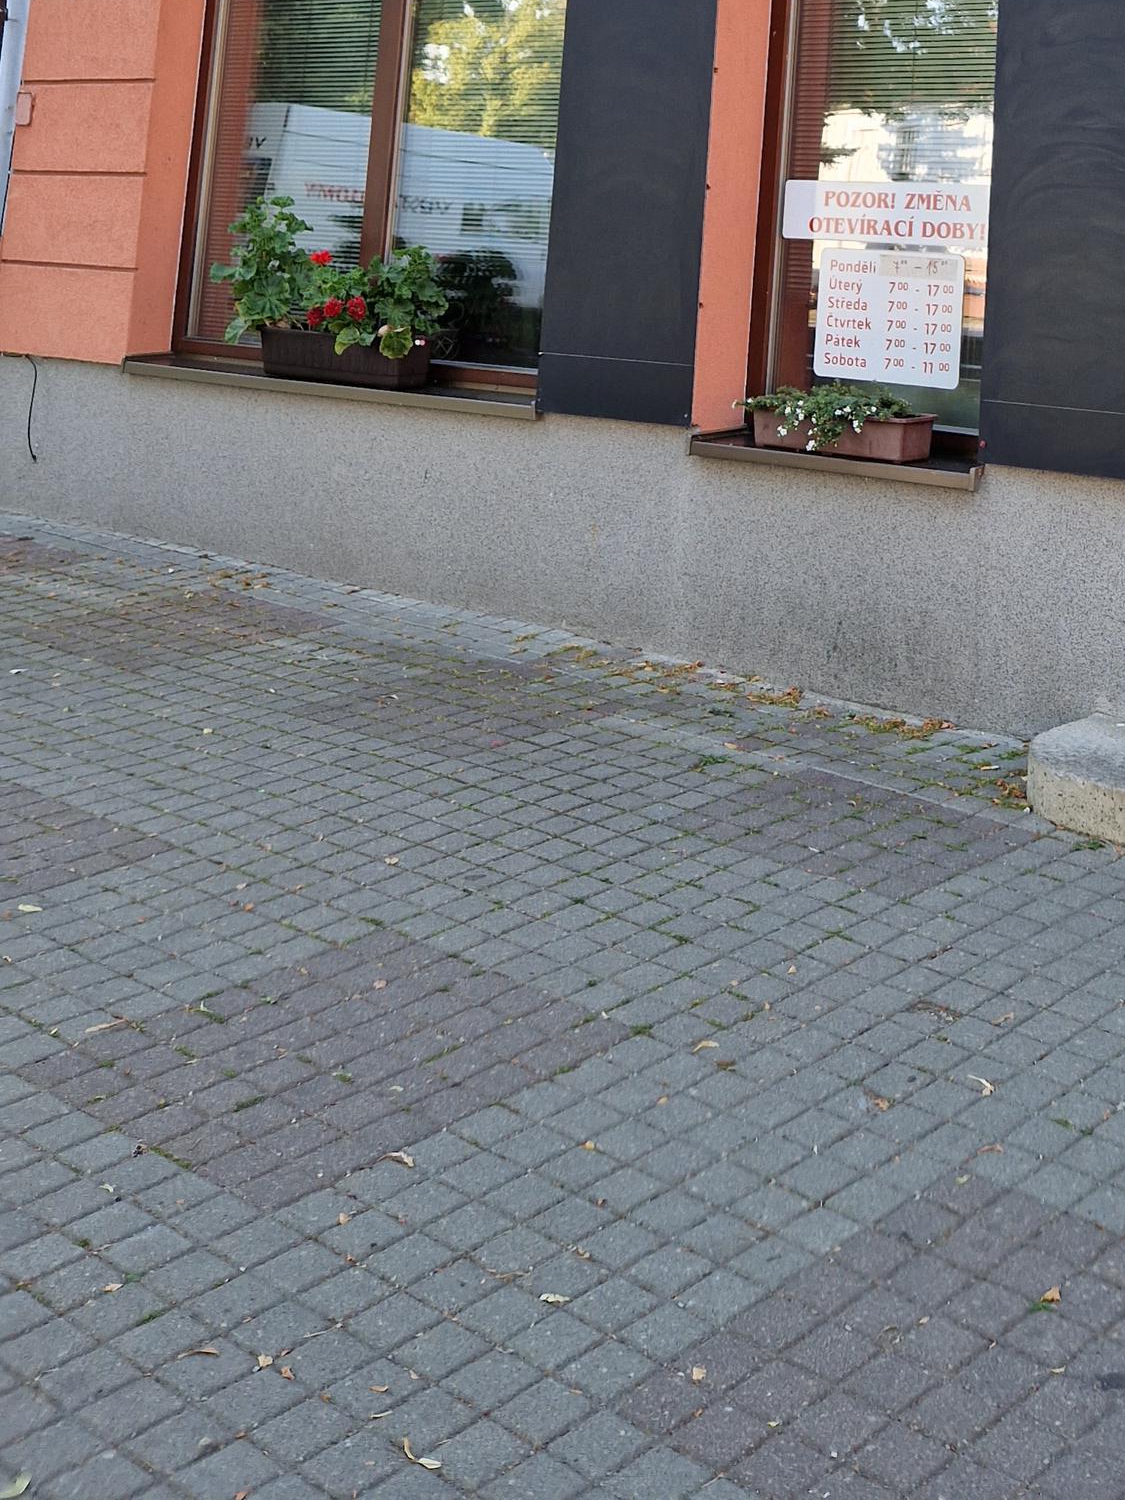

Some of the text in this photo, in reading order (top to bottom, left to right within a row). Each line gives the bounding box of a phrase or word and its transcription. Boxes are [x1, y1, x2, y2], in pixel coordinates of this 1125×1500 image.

[824, 190, 972, 211] POZOR! ZMĚNA
[809, 214, 986, 241] OTEVÍRACÍ DOBY!
[828, 276, 863, 295] Úterý
[827, 296, 868, 311] Středa
[826, 315, 872, 330] Čtvrtek
[825, 334, 861, 348] Pátek
[824, 353, 867, 368] Sobota
